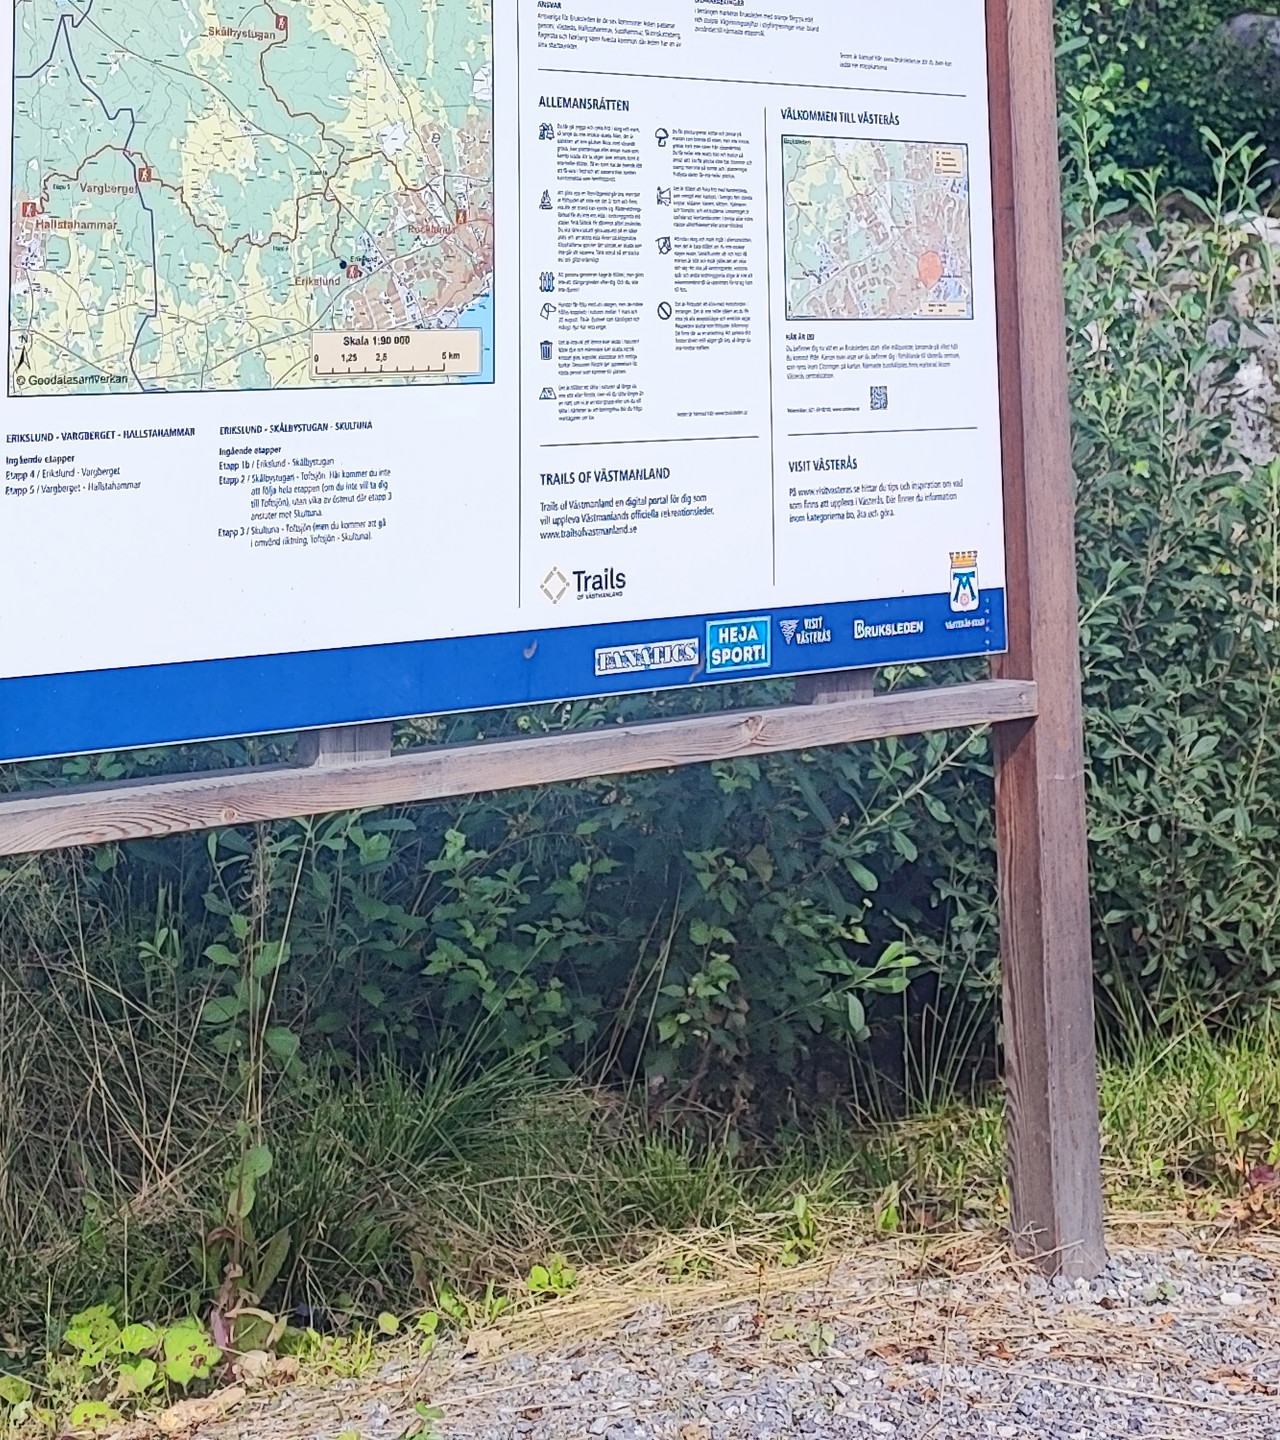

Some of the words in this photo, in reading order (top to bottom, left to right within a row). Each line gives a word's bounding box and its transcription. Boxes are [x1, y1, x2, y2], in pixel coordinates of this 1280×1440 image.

[538, 95, 629, 112] ALLEMANSRÄTTEN
[780, 106, 837, 122] VÄLKOMMEN
[838, 111, 856, 123] TILL
[857, 110, 900, 126] VÄSTERÅS
[343, 336, 369, 346] Skala
[373, 336, 391, 345] 1:90
[394, 336, 410, 344] 000
[314, 354, 319, 362] 0
[341, 354, 357, 362] 1,25
[376, 353, 387, 361] 2,5
[442, 352, 446, 360] 5
[448, 352, 460, 360] km
[788, 460, 811, 473] VISIT
[812, 455, 858, 471] VÄSTERÅS
[540, 471, 575, 486] TRAILS
[578, 470, 592, 483] OF
[593, 467, 670, 483] VÄSTMANLAND
[573, 567, 626, 592] Trails
[804, 617, 822, 629] VISIT
[854, 619, 923, 639] BRUKSLEDEN
[719, 626, 758, 642] HEJA
[597, 641, 697, 671] FANATICS
